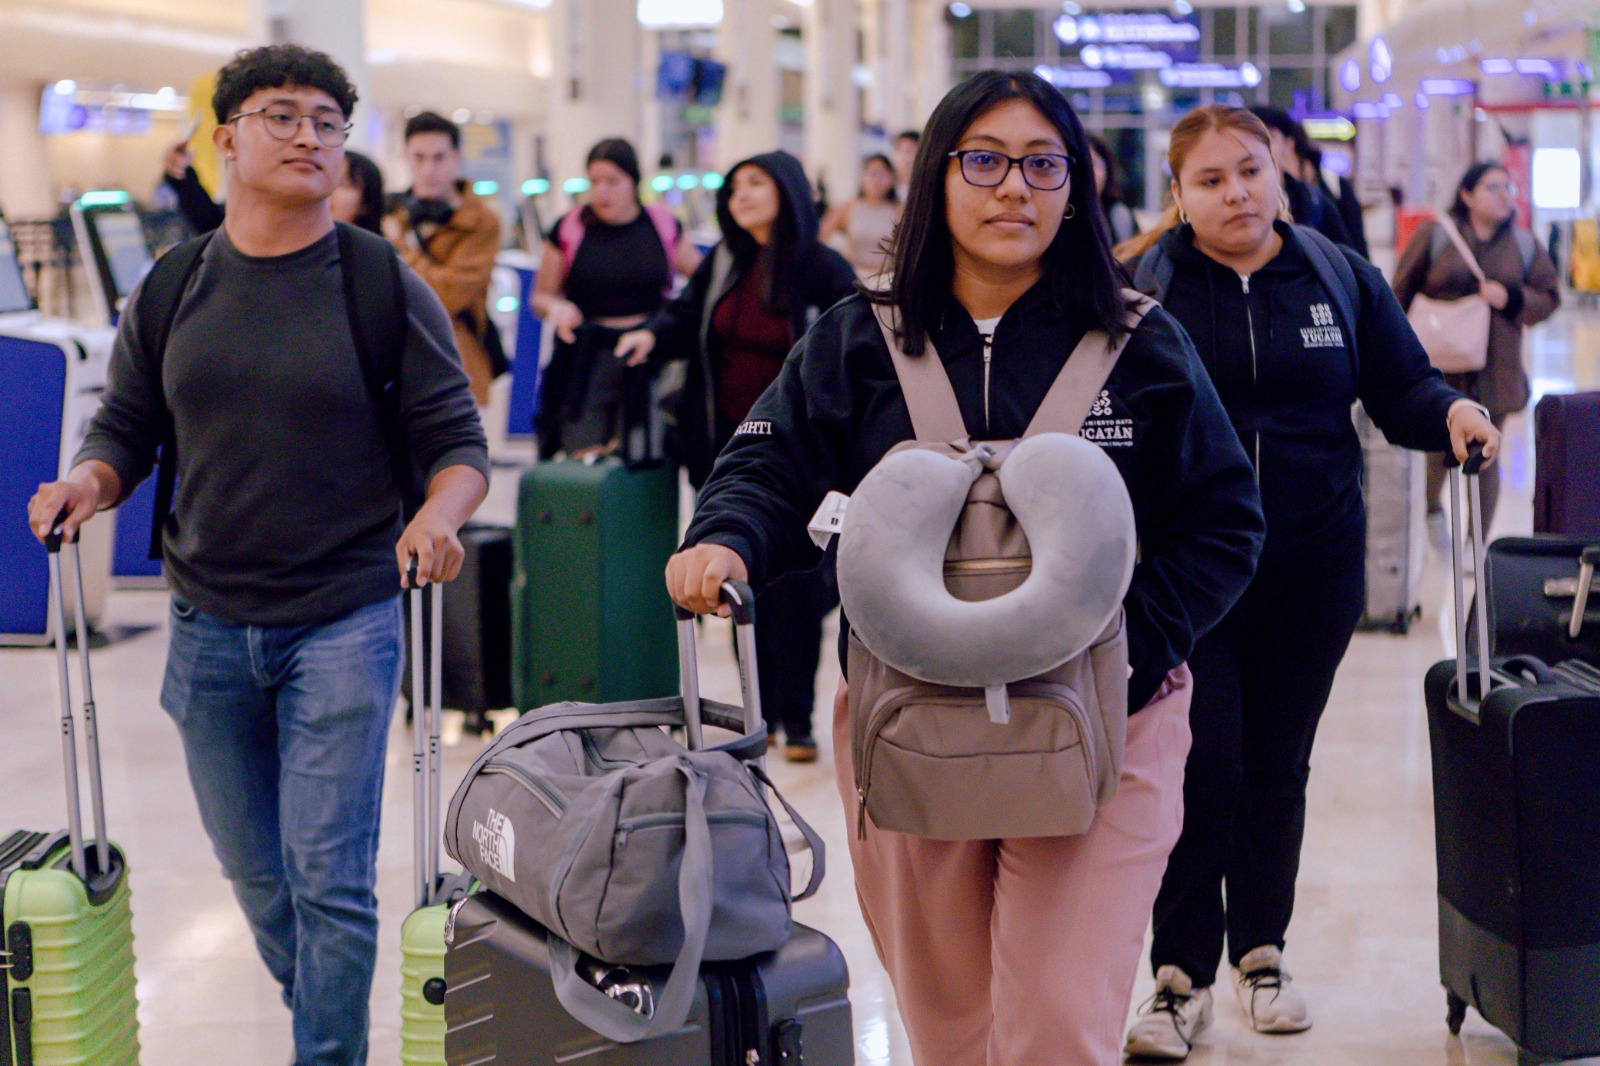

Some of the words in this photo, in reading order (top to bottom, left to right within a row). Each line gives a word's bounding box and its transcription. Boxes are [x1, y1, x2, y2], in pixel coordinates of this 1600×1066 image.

[1077, 425, 1133, 440] UCATÁN
[486, 808, 505, 833] THE
[472, 820, 501, 853] NORTH
[479, 845, 501, 872] FACE
